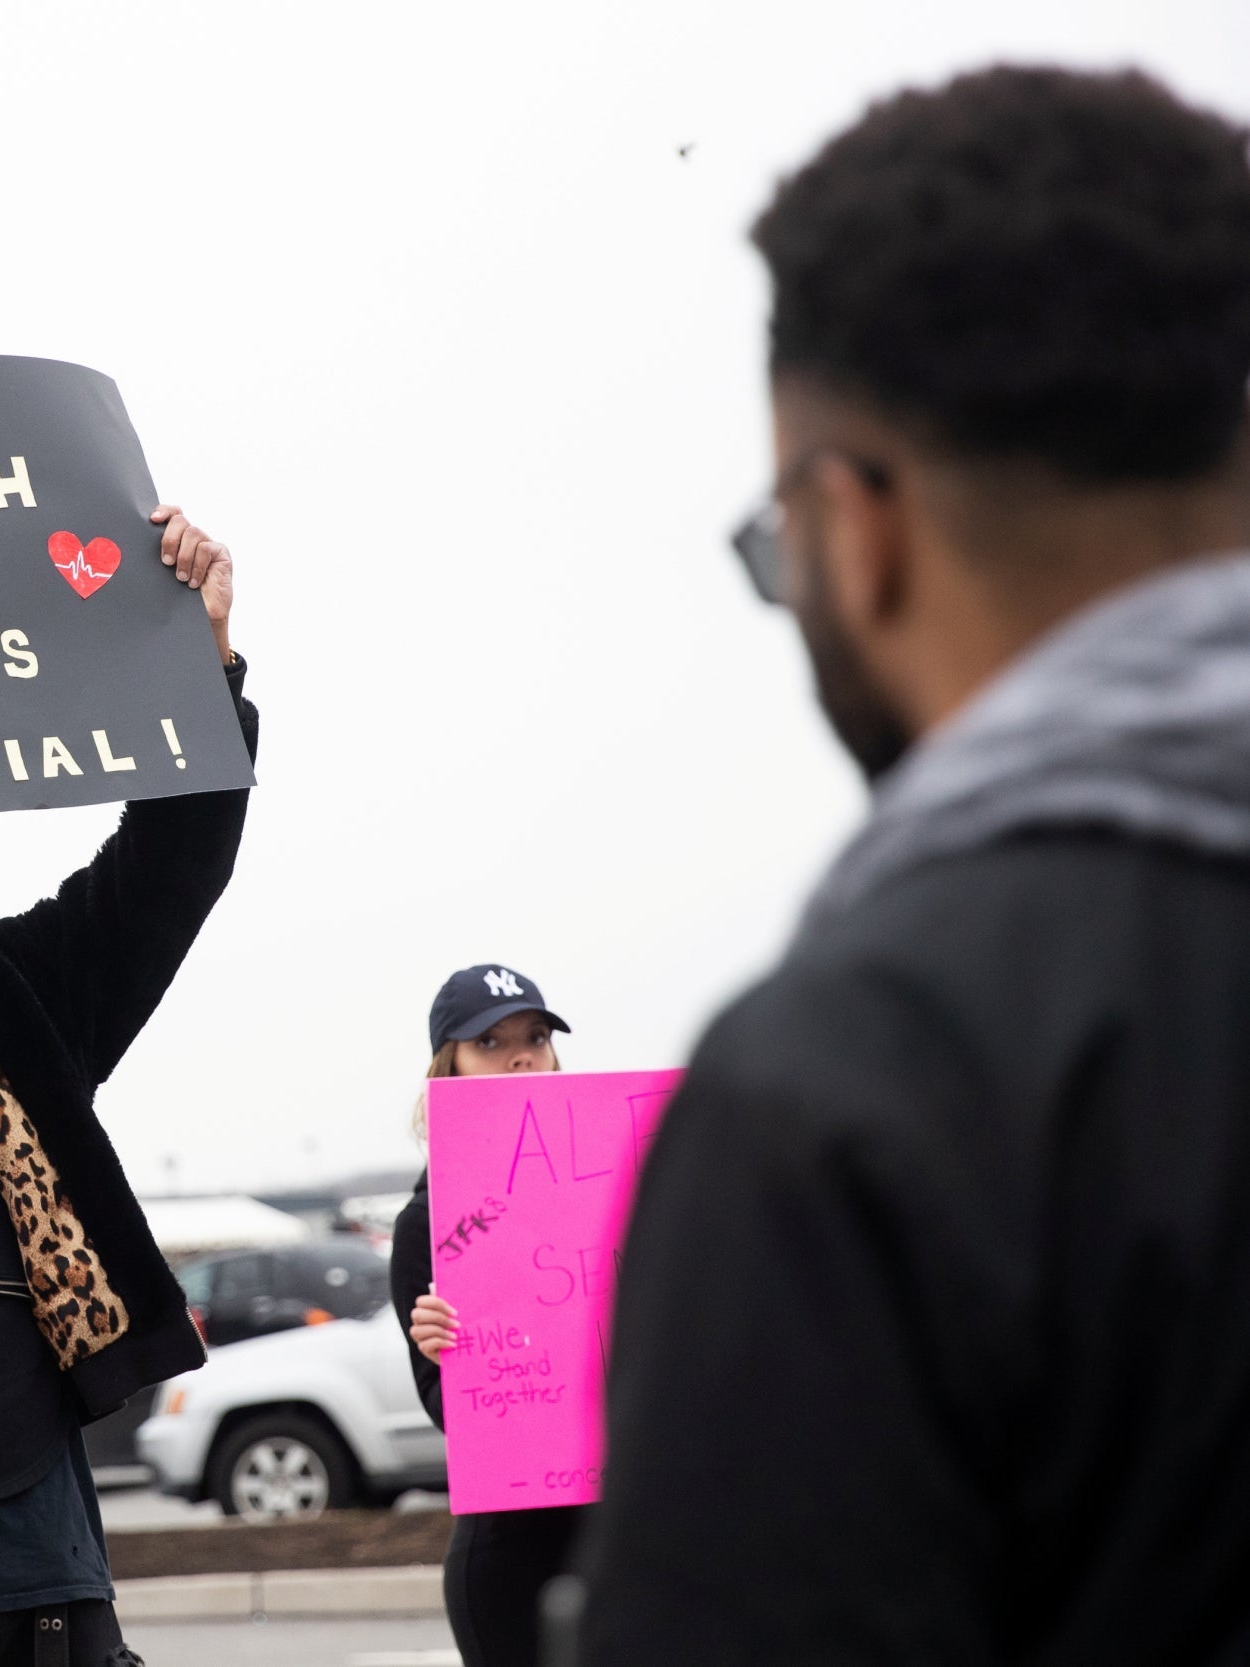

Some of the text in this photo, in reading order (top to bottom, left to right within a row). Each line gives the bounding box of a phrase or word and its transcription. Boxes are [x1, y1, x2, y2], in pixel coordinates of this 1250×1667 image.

[483, 968, 525, 997] NY
[487, 1349, 551, 1382] Stand
[461, 1380, 567, 1419] Together
